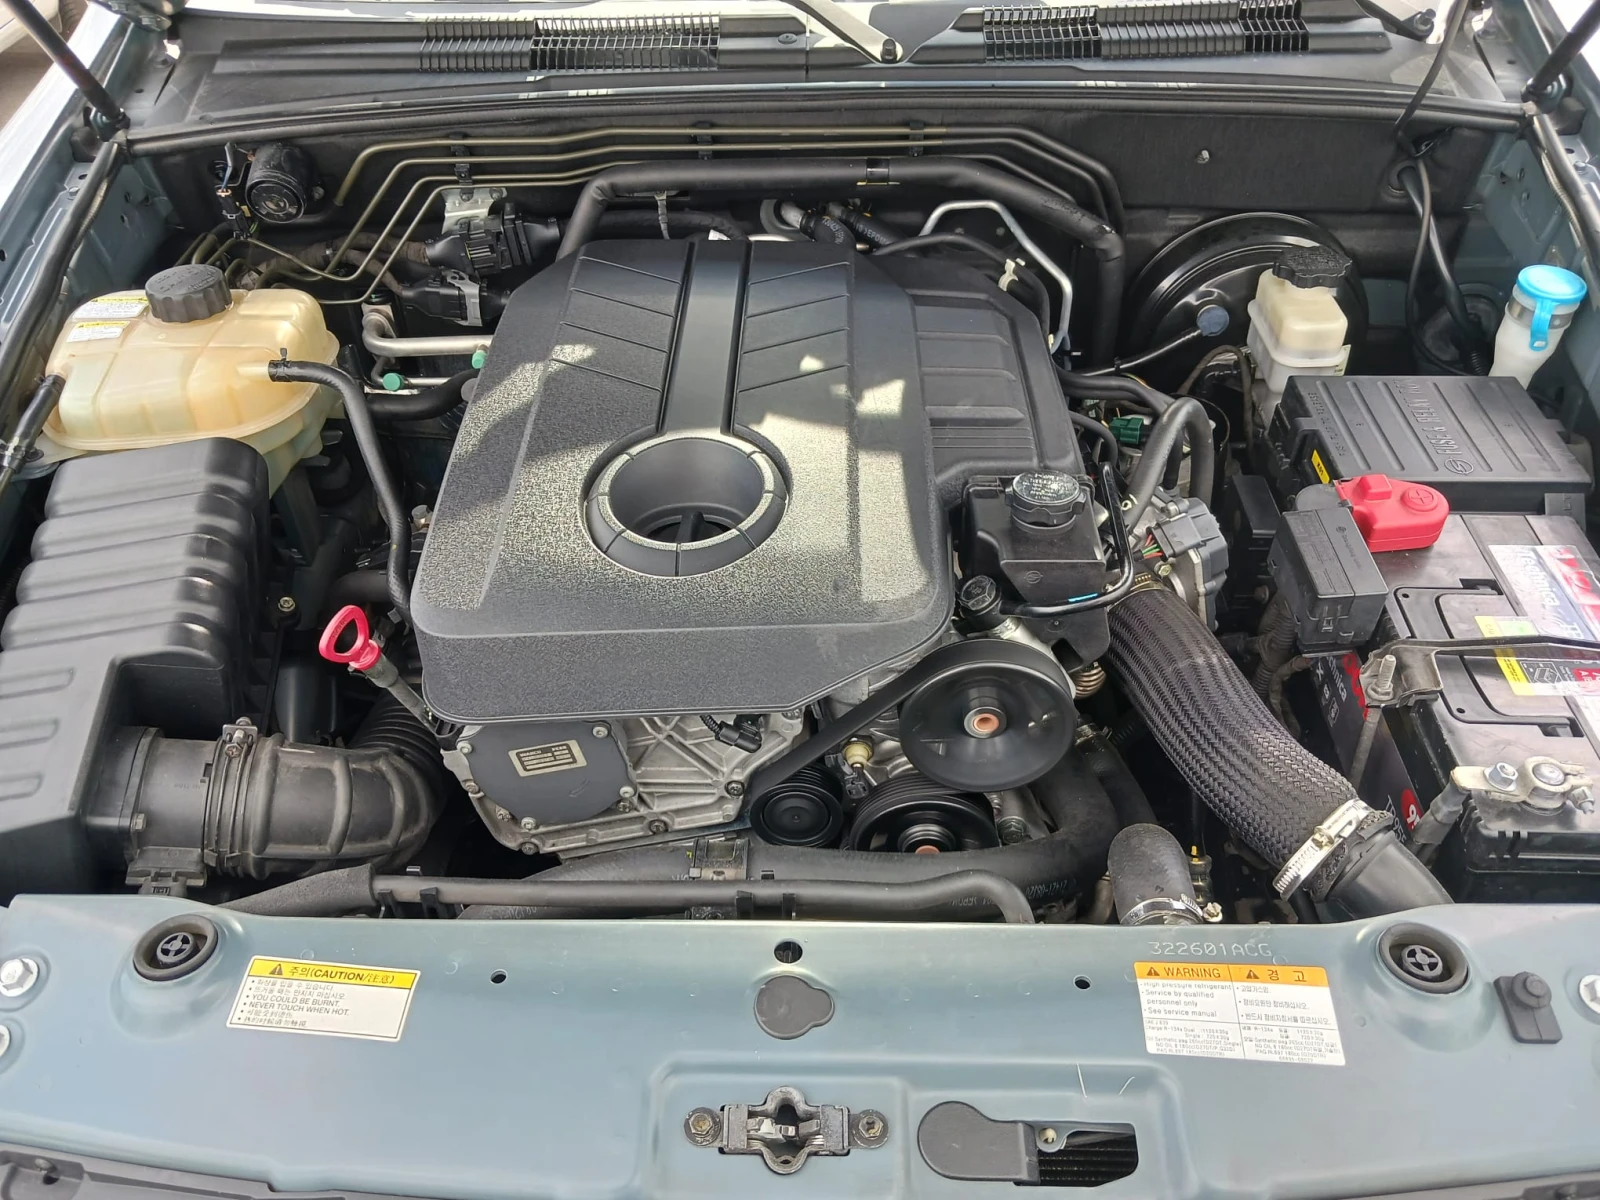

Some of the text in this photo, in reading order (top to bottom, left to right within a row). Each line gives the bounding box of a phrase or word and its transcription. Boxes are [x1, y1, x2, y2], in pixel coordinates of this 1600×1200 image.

[1405, 397, 1442, 423] RELAY
[1425, 434, 1462, 455] FUSE
[1518, 549, 1562, 607] Technica
[1148, 942, 1273, 957] 322601ACG
[1164, 967, 1221, 978] WARNING
[1267, 969, 1307, 982] 경 고
[312, 999, 340, 1007] BURNT.
[1147, 998, 1181, 1006] personnel
[277, 1003, 304, 1011] TOUCH
[306, 1006, 333, 1014] WHEN
[332, 1008, 349, 1016] HOT.
